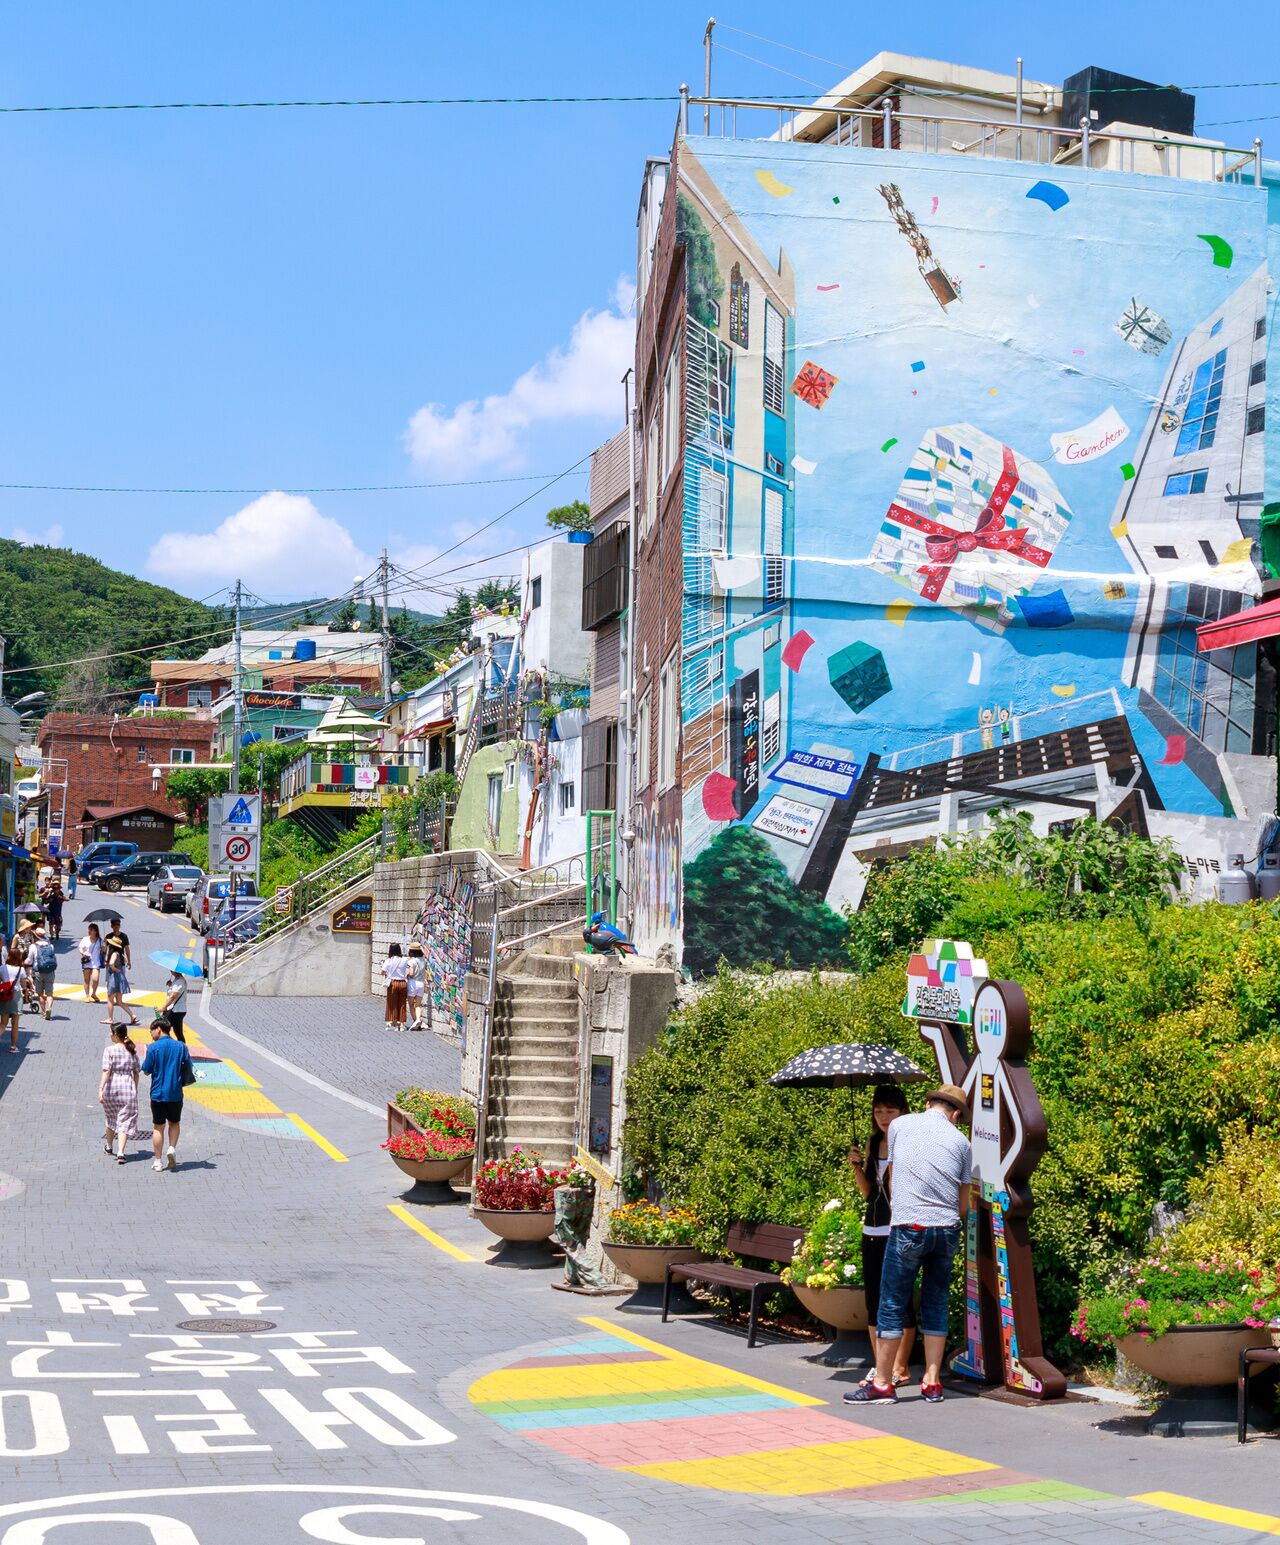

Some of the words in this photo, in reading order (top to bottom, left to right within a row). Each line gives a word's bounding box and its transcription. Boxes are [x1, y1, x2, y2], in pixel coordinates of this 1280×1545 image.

[793, 752, 814, 763] 벽화
[814, 757, 835, 770] 제작
[231, 844, 245, 855] 30
[1179, 855, 1221, 878] 늘마루
[916, 986, 961, 1011] 감천문화마을
[974, 1125, 1000, 1143] Welcome
